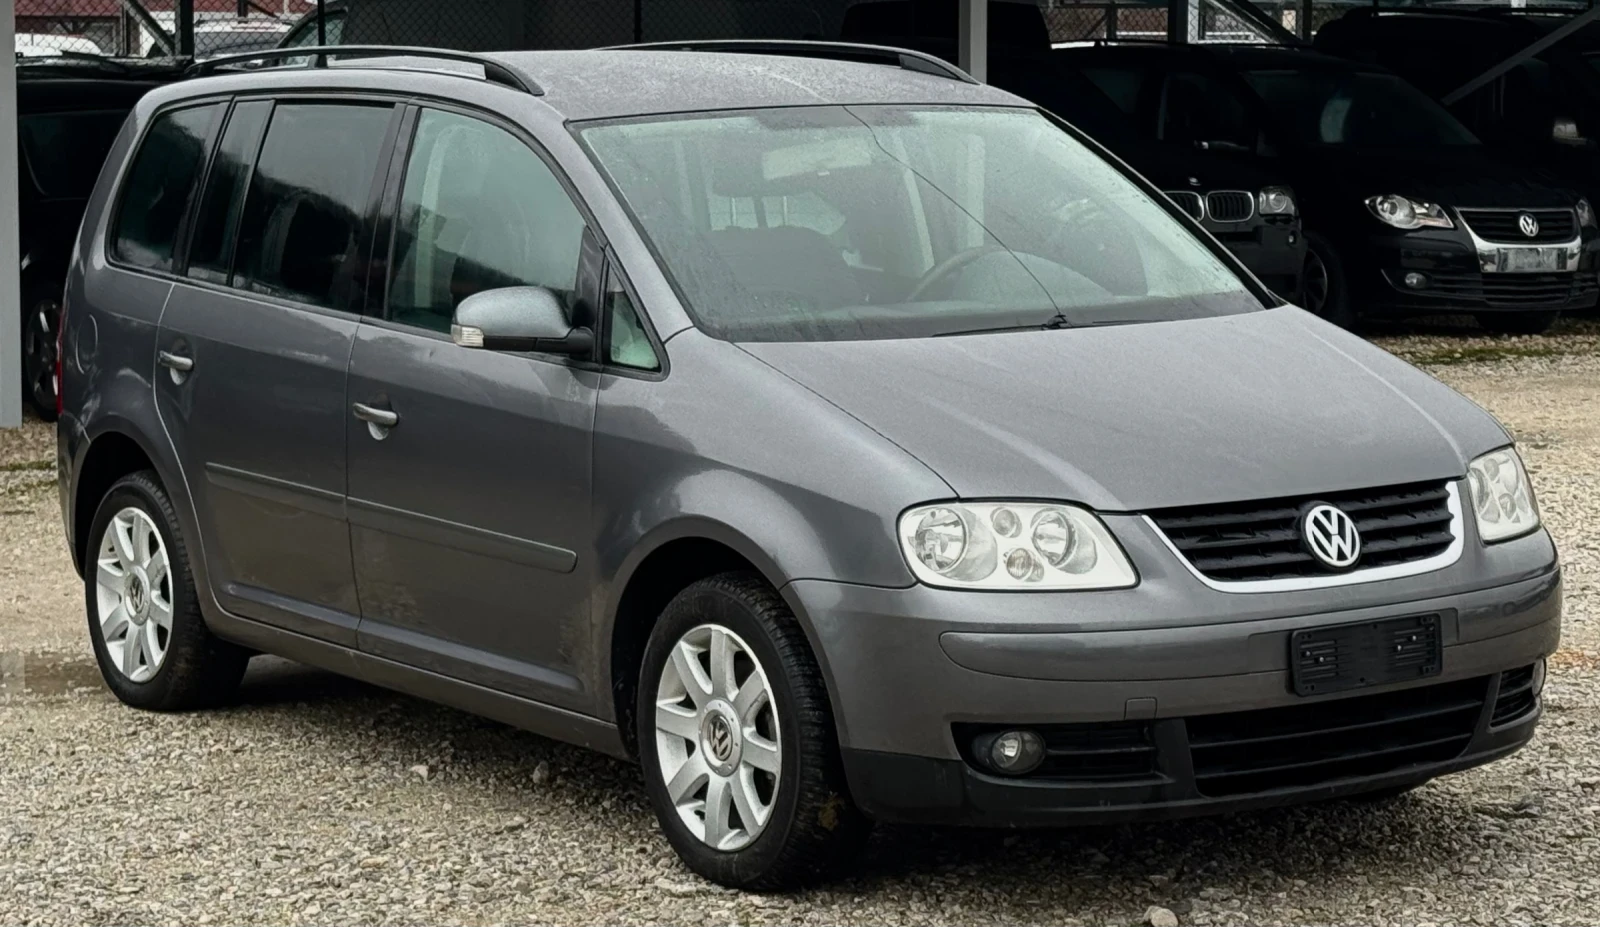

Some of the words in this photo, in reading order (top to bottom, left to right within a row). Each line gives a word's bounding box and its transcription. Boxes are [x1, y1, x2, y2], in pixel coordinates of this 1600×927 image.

[1519, 214, 1539, 237] VW
[1305, 505, 1361, 567] VW
[709, 714, 733, 762] VW
